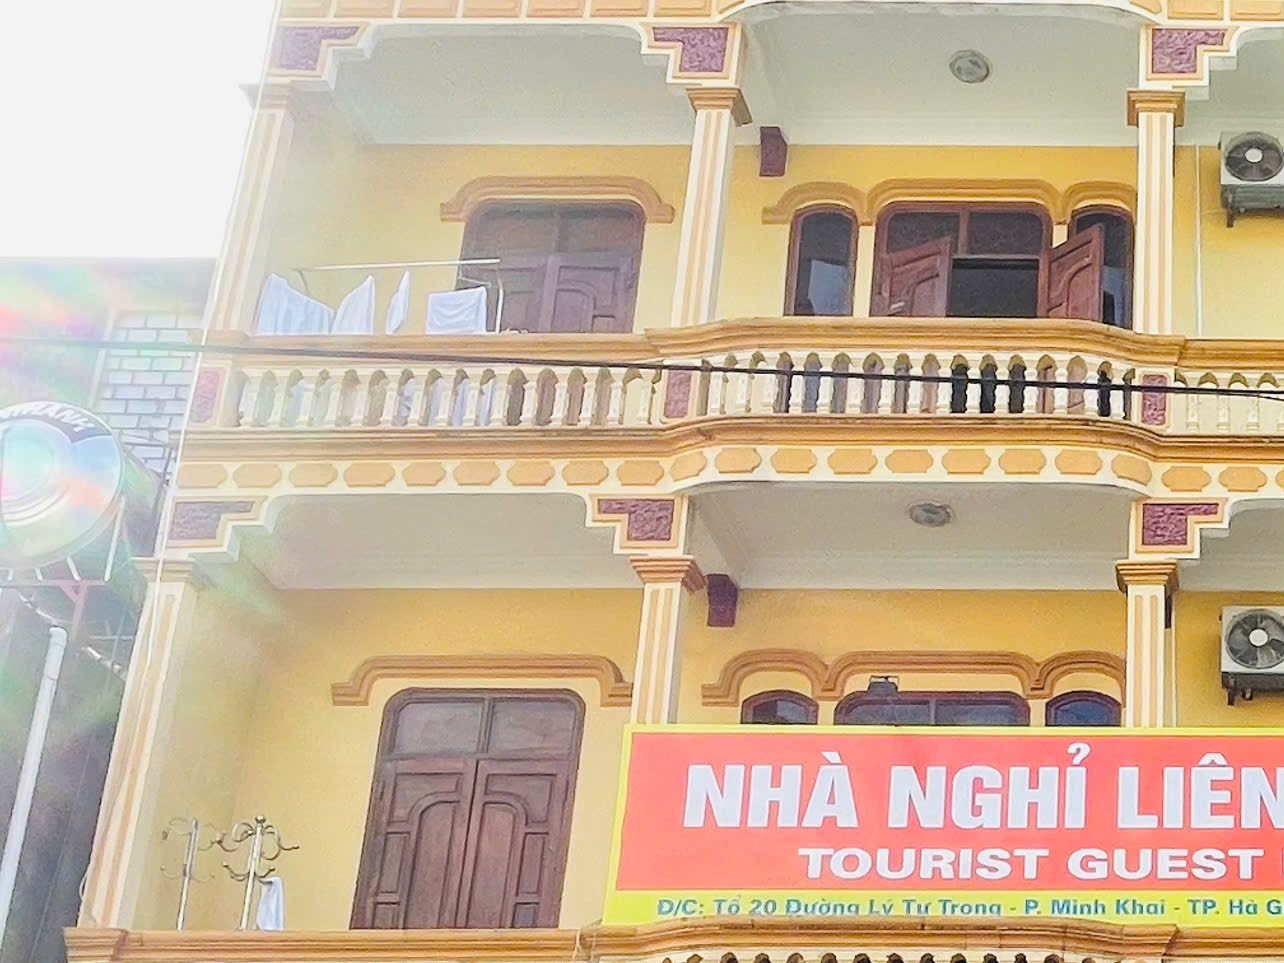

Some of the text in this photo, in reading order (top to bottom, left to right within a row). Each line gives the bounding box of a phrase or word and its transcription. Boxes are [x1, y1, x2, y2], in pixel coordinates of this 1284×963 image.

[683, 751, 858, 828] NHÀ
[888, 743, 1090, 829] NGHỈ
[798, 848, 1049, 880] TOURIST
[1067, 847, 1264, 880] GUEST
[657, 899, 704, 916] Đ/C:
[749, 899, 777, 915] 20
[1025, 899, 1041, 914] P.
[1051, 899, 1106, 914] Minh
[1115, 899, 1166, 914] Khai
[1187, 899, 1220, 914] TP.
[1229, 899, 1258, 914] Hà
